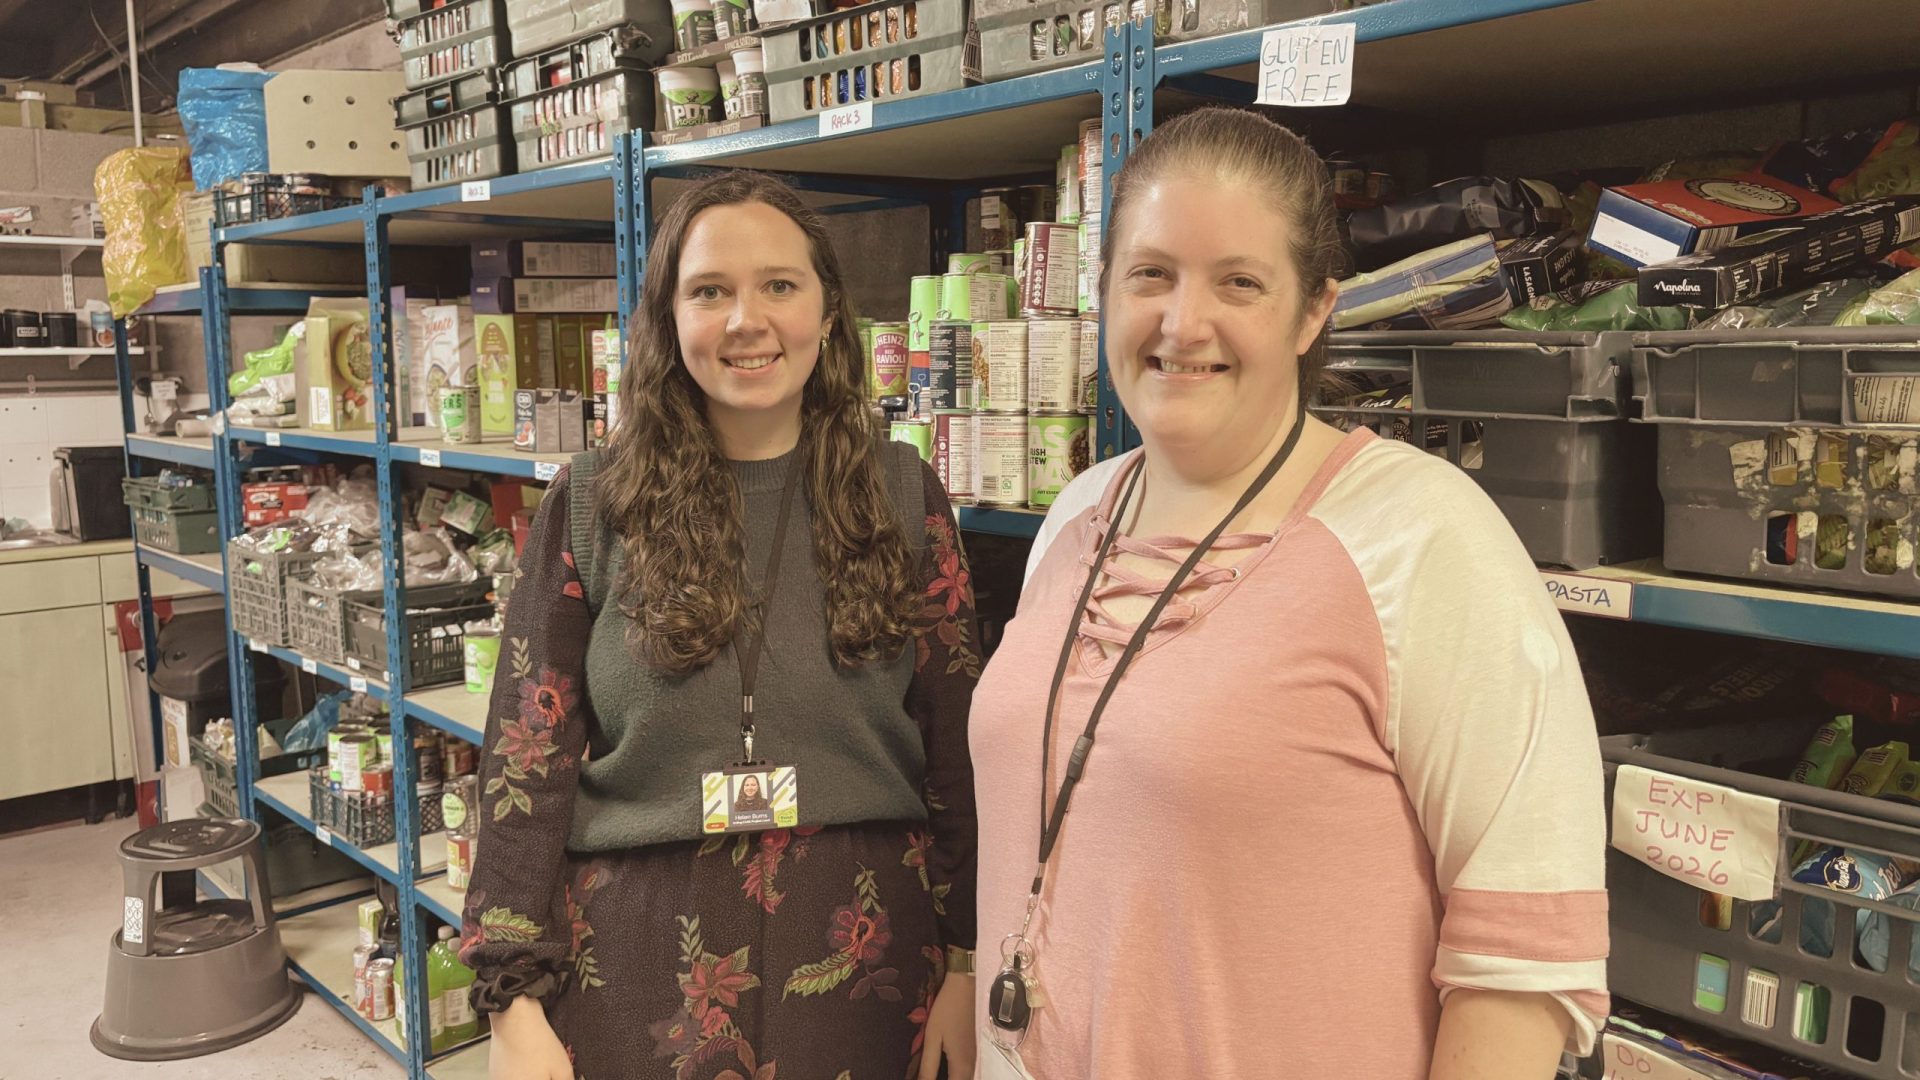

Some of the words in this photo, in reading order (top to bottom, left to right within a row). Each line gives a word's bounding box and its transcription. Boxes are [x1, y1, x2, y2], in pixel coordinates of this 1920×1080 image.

[1261, 35, 1348, 66] GLUTEN
[1264, 66, 1341, 103] FREE
[672, 103, 711, 121] POT
[724, 97, 740, 115] PO
[832, 113, 852, 130] RACK
[854, 110, 861, 124] 3
[1522, 266, 1536, 299] LASAGN
[1653, 278, 1701, 295] Napolina
[877, 334, 903, 346] HEINZ
[876, 354, 906, 364] RAVIOLI
[1545, 580, 1611, 607] PASTA
[1636, 810, 1735, 851] JUNE
[1646, 845, 1729, 885] 2026
